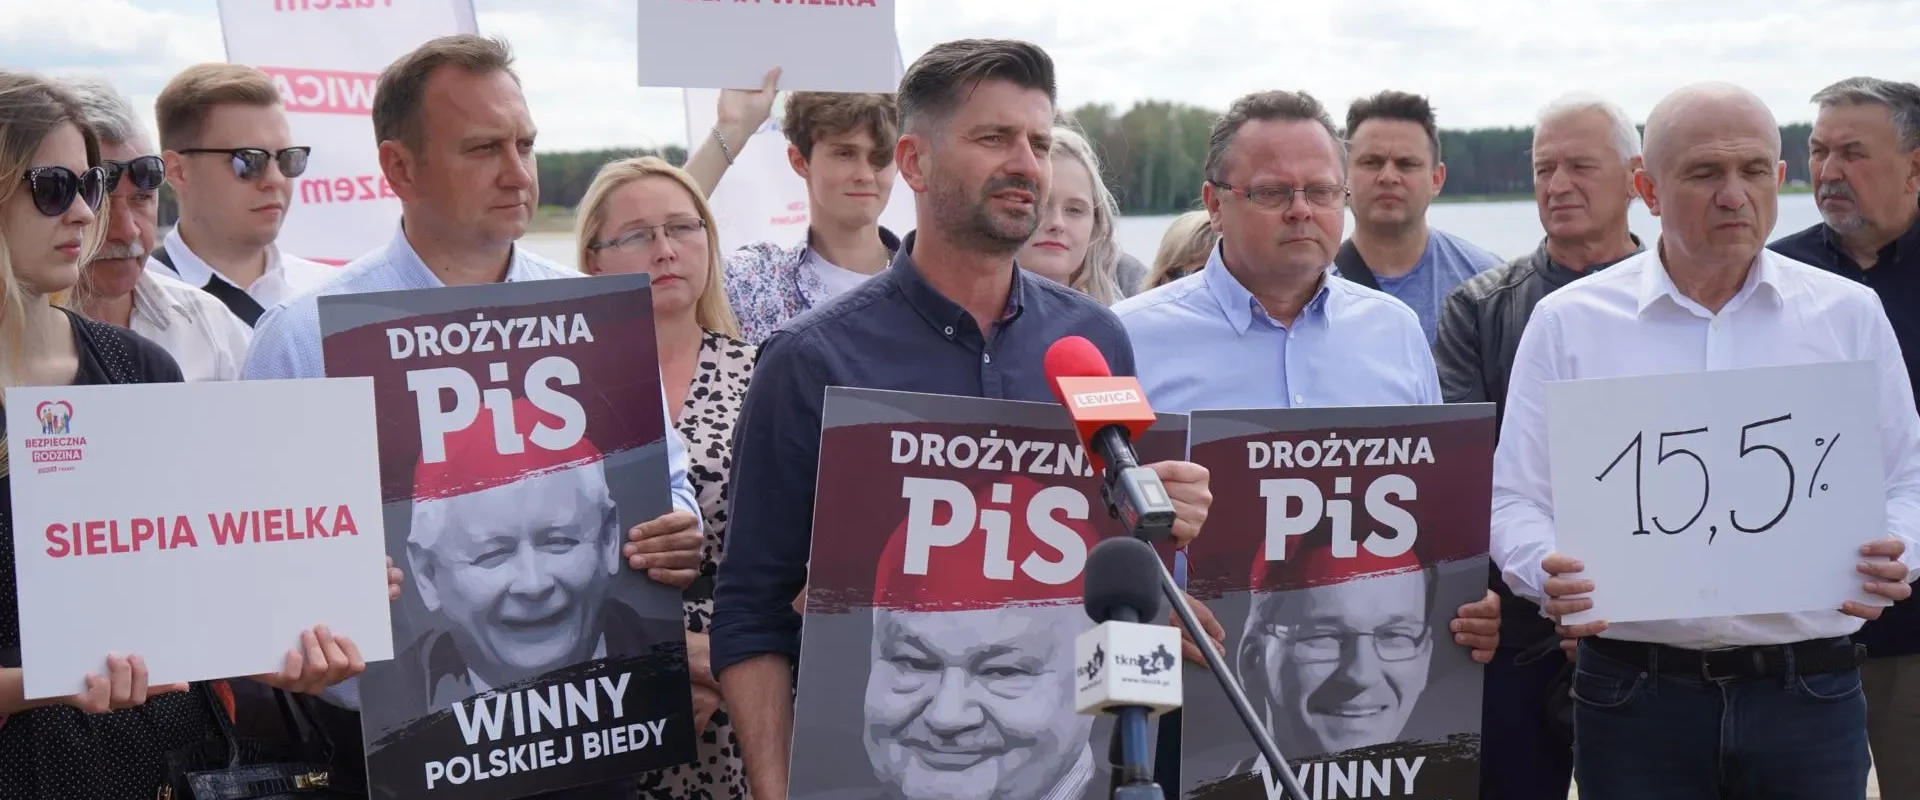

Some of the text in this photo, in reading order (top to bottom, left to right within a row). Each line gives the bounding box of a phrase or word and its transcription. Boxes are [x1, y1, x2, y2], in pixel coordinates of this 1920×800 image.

[386, 313, 594, 360] DROŻYZNA
[406, 356, 587, 464] PiS
[1077, 391, 1138, 405] LEWICA
[25, 436, 87, 449] BEZPIECZNA
[33, 450, 81, 461] RODZINA
[1247, 432, 1435, 469] DROŻYZNA
[45, 504, 359, 558] SIELPIA WIELKA
[902, 476, 1090, 585] PiS
[1260, 473, 1418, 561] PiS
[452, 672, 632, 746] WINNY
[425, 718, 668, 790] POLSKIEJ BIEDY
